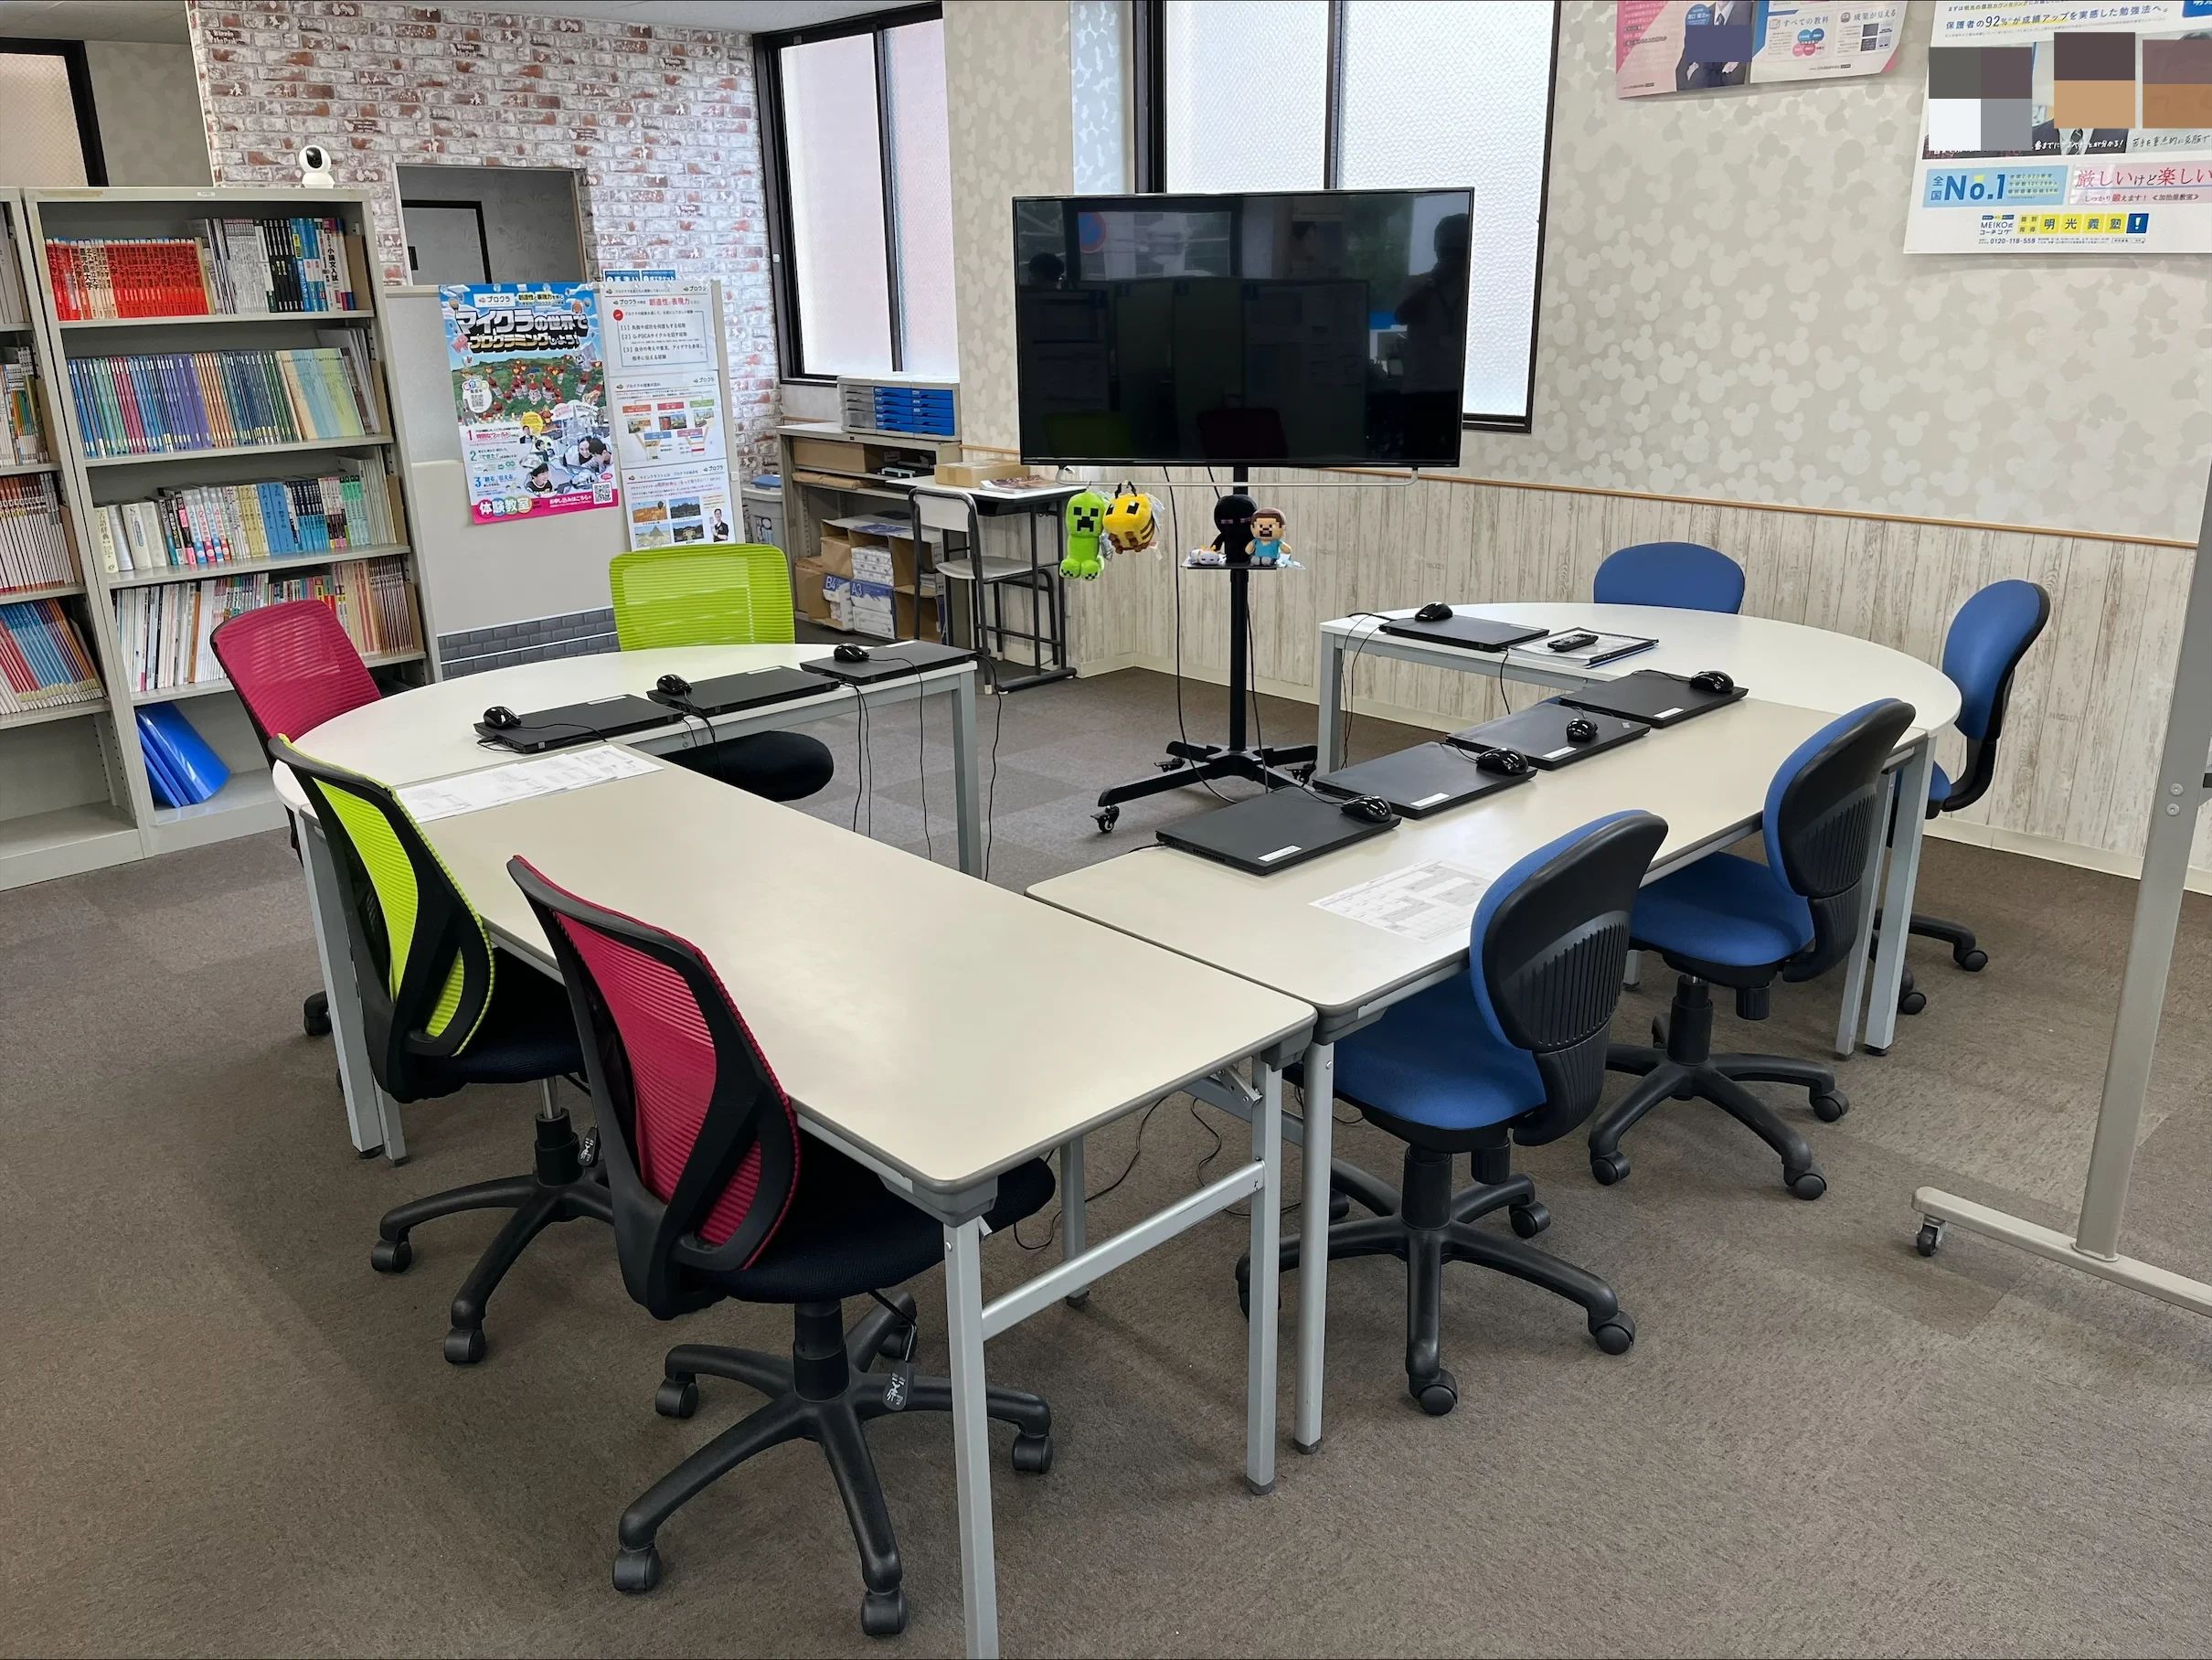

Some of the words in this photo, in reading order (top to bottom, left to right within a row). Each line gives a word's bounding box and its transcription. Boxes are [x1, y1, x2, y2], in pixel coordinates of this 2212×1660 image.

[1943, 174, 2005, 201] No.1
[2075, 166, 2212, 191] 厳しいけど楽しい
[455, 309, 589, 335] マイクラの世界で
[470, 332, 580, 350] プログラミングしよう!
[479, 497, 530, 515] 体験教室
[825, 576, 836, 590] B4
[852, 583, 863, 597] A3
